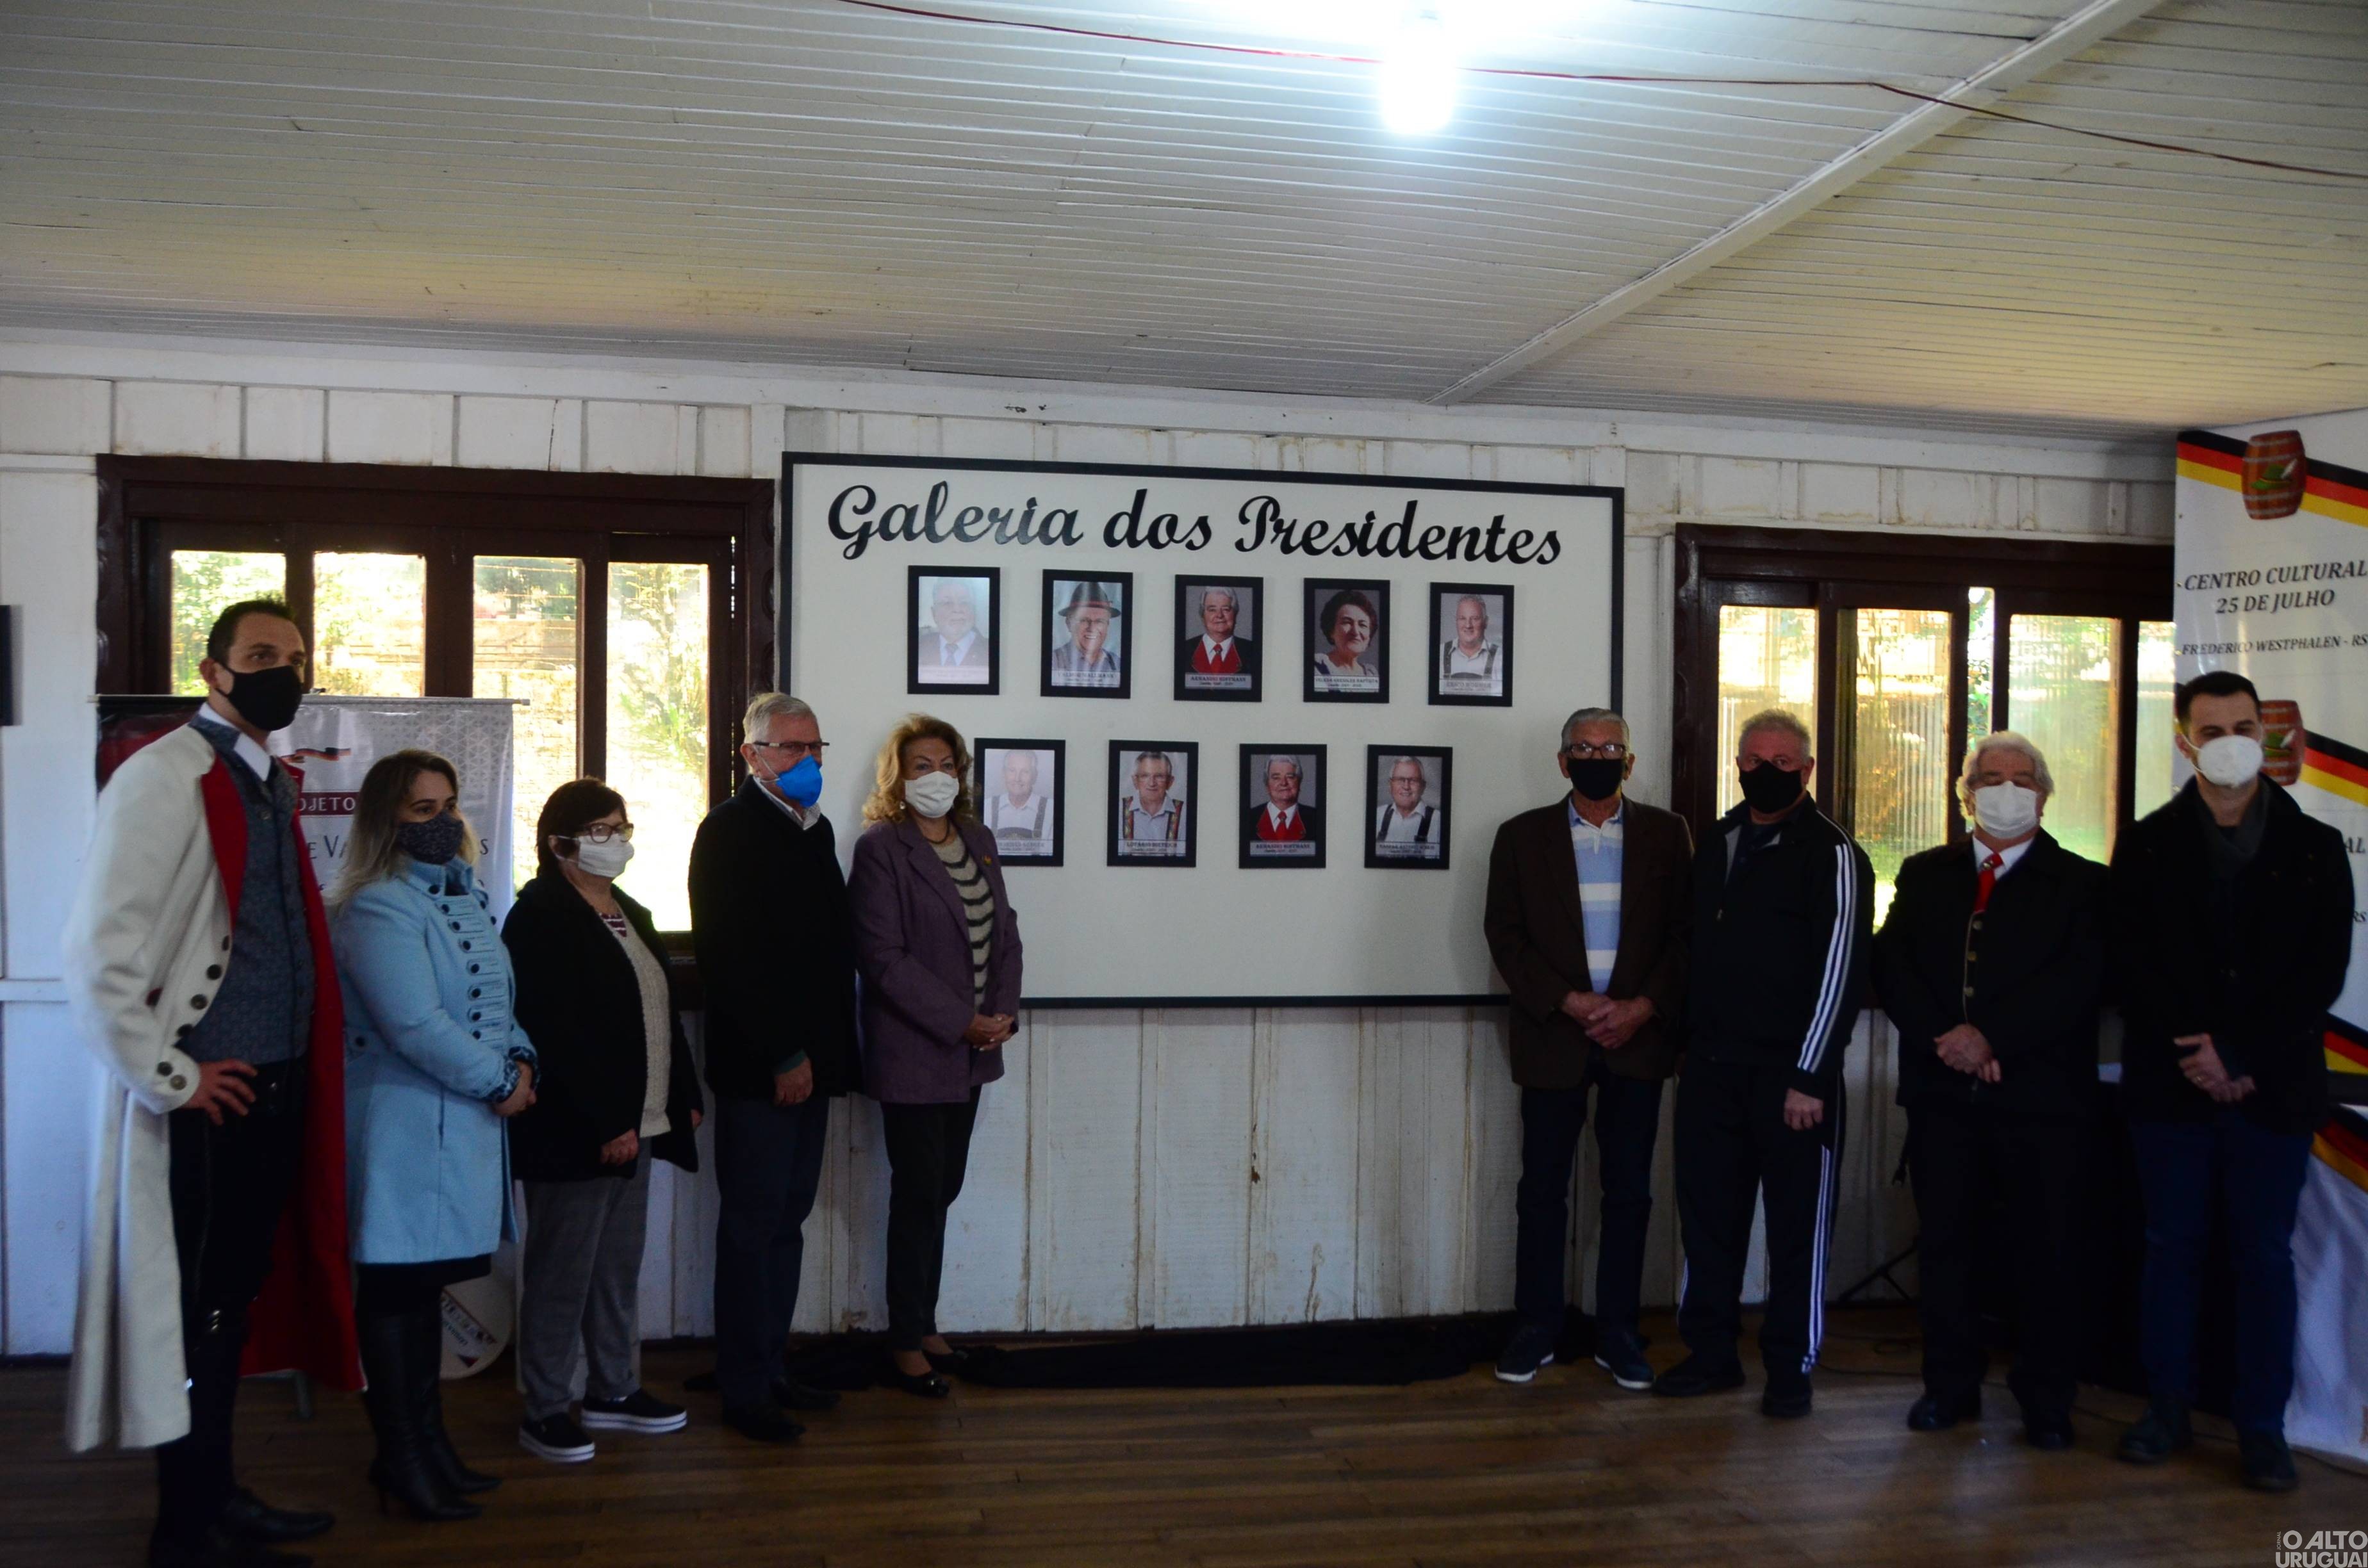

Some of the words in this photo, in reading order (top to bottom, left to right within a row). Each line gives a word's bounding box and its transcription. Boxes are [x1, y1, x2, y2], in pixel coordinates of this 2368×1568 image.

[828, 480, 1083, 559] Galeria
[1103, 488, 1212, 550] dos
[1237, 494, 1561, 564] Presidentes
[2185, 569, 2261, 591] CENTRO
[2266, 560, 2368, 584] CULTURAL
[2216, 597, 2239, 614] 25
[2244, 594, 2269, 611] DE
[2272, 589, 2335, 614] JULHO
[2182, 643, 2252, 655] FREDERICO
[2256, 635, 2340, 651] WESTPHALEN
[2352, 634, 2368, 646] RS
[298, 797, 356, 812] OJETO
